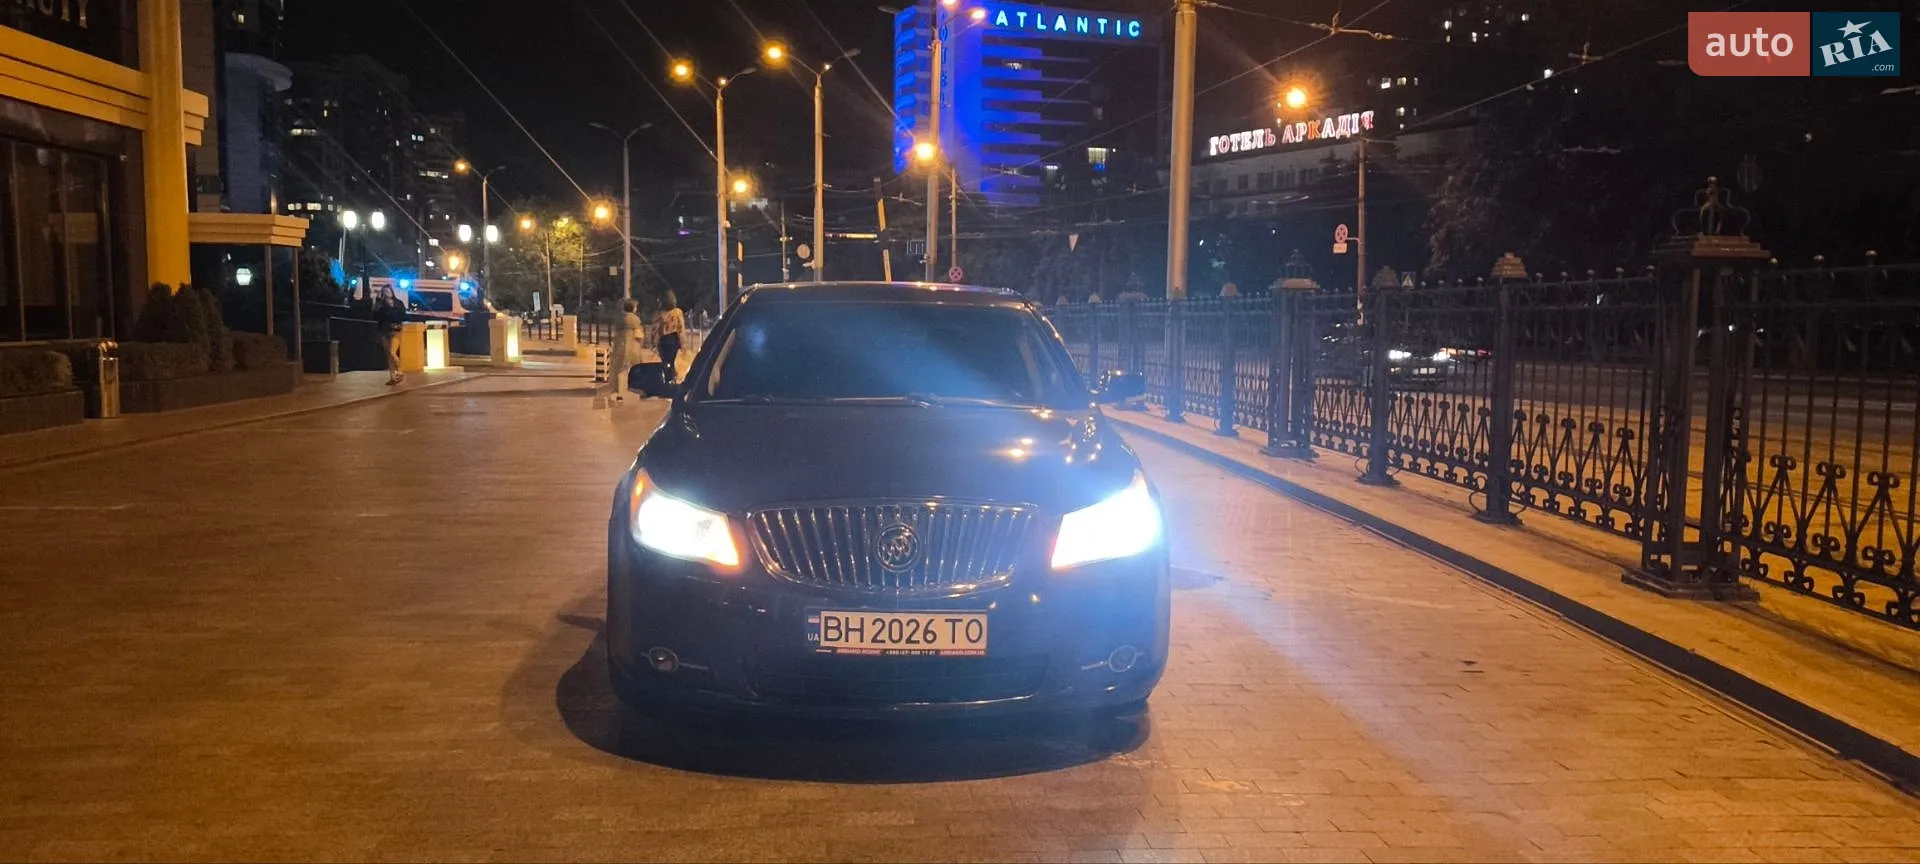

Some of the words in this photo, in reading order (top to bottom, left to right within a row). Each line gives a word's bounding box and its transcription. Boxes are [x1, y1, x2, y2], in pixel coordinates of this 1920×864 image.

[995, 10, 1142, 37] ATLANTIC
[1209, 127, 1276, 156] ГОТЕЛЬ
[807, 633, 820, 642] UA
[823, 616, 865, 643] BH
[870, 617, 938, 644] 2026
[944, 618, 983, 644] TO
